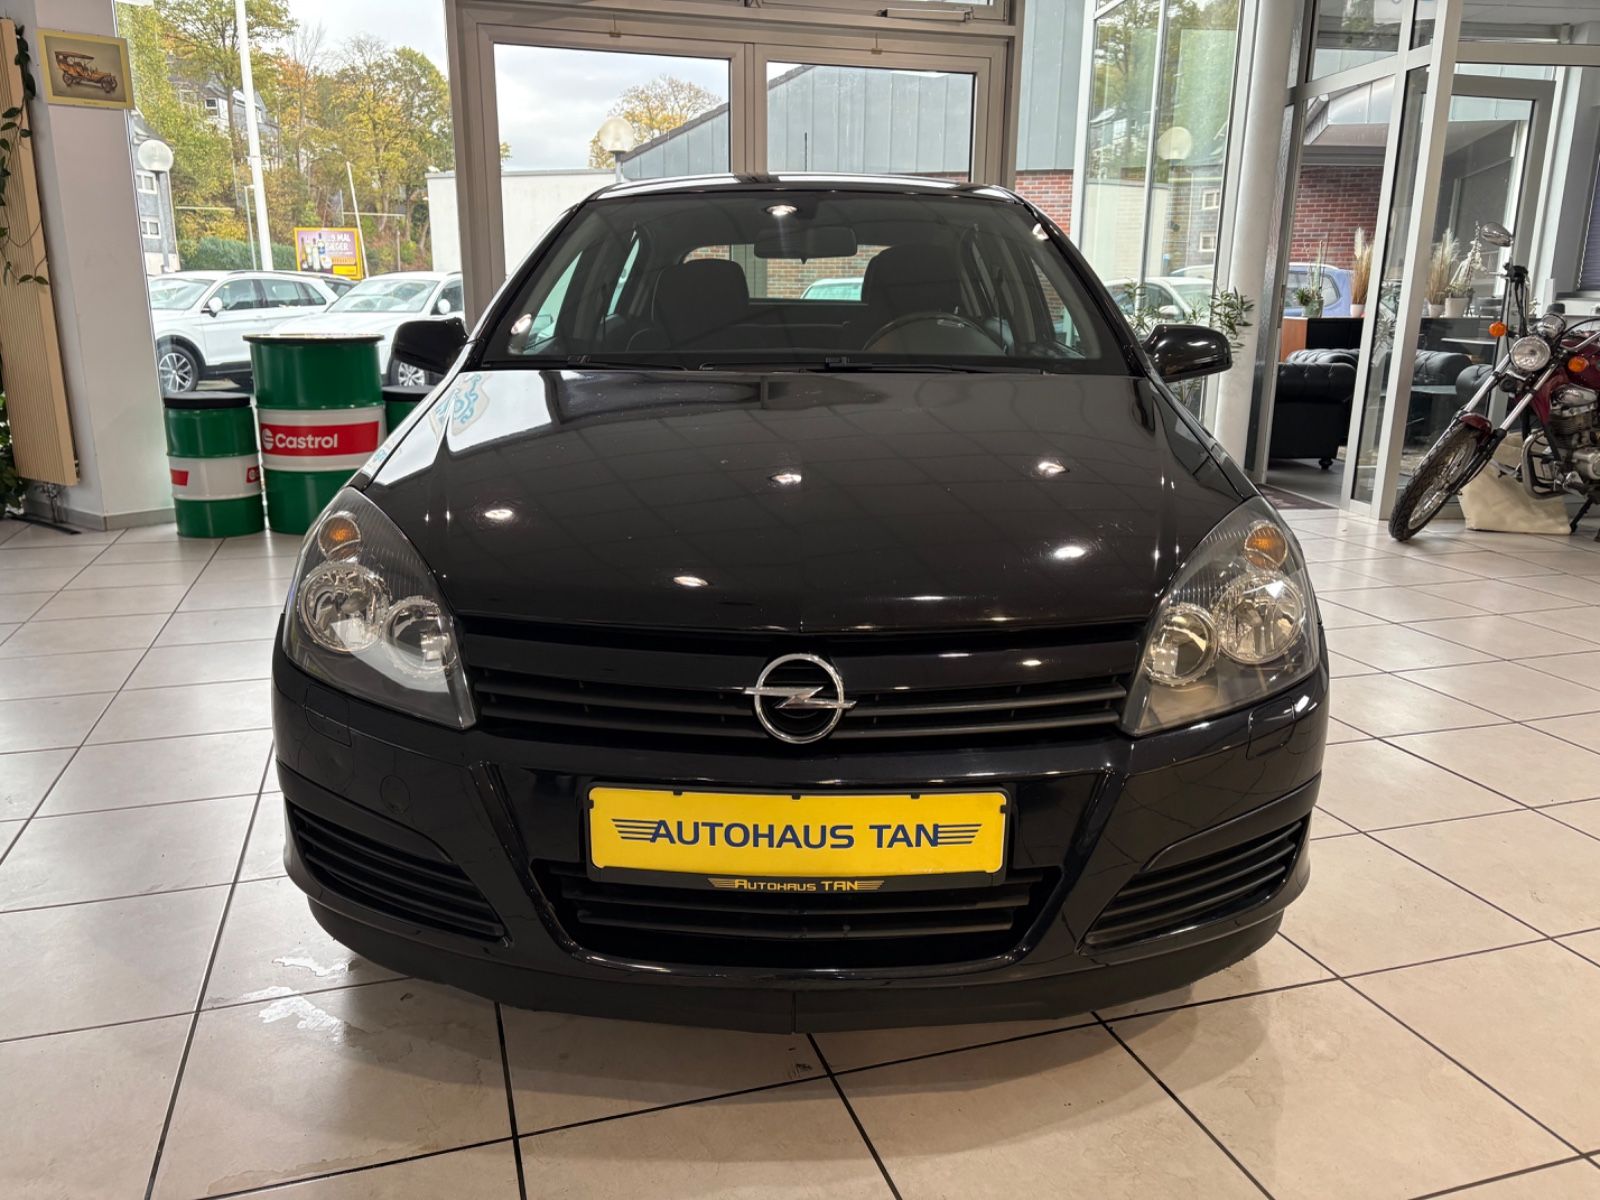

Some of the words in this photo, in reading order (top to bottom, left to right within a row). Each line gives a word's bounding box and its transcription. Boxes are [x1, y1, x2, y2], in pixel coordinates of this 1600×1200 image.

[275, 433, 338, 448] Castrol
[651, 820, 855, 849] AUTOHAUS
[869, 823, 939, 848] TAN
[820, 880, 859, 891] TAN
